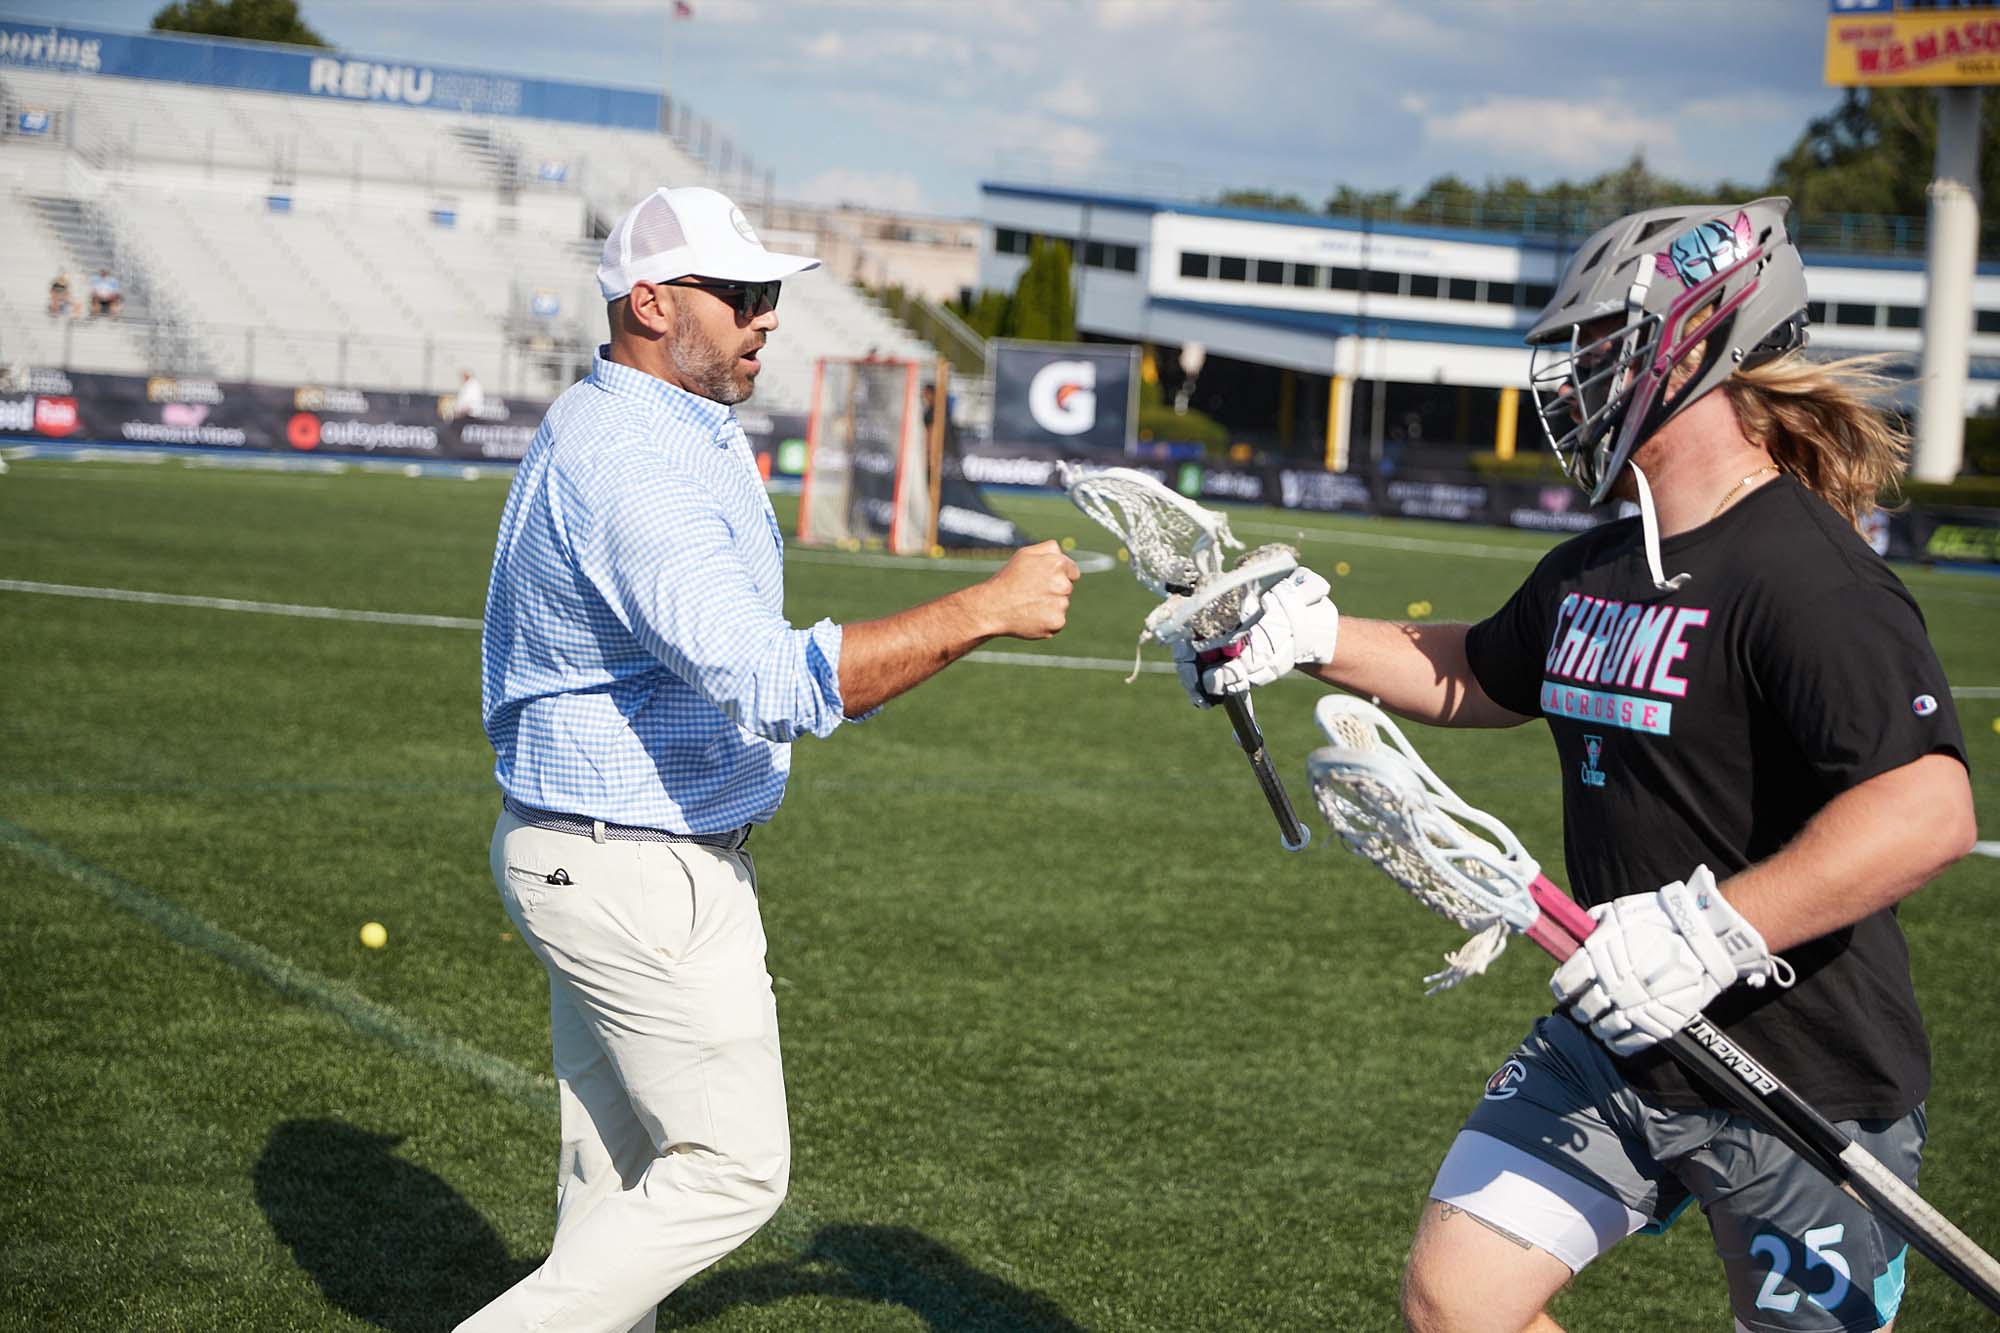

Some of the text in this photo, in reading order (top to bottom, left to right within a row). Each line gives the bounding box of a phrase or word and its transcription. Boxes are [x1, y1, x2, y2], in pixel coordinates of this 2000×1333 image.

[309, 58, 434, 104] RENU
[1029, 360, 1097, 436] G
[1545, 592, 1709, 696] CHROME
[1541, 684, 1658, 727] LACROSSE
[1750, 1223, 1852, 1313] 25
